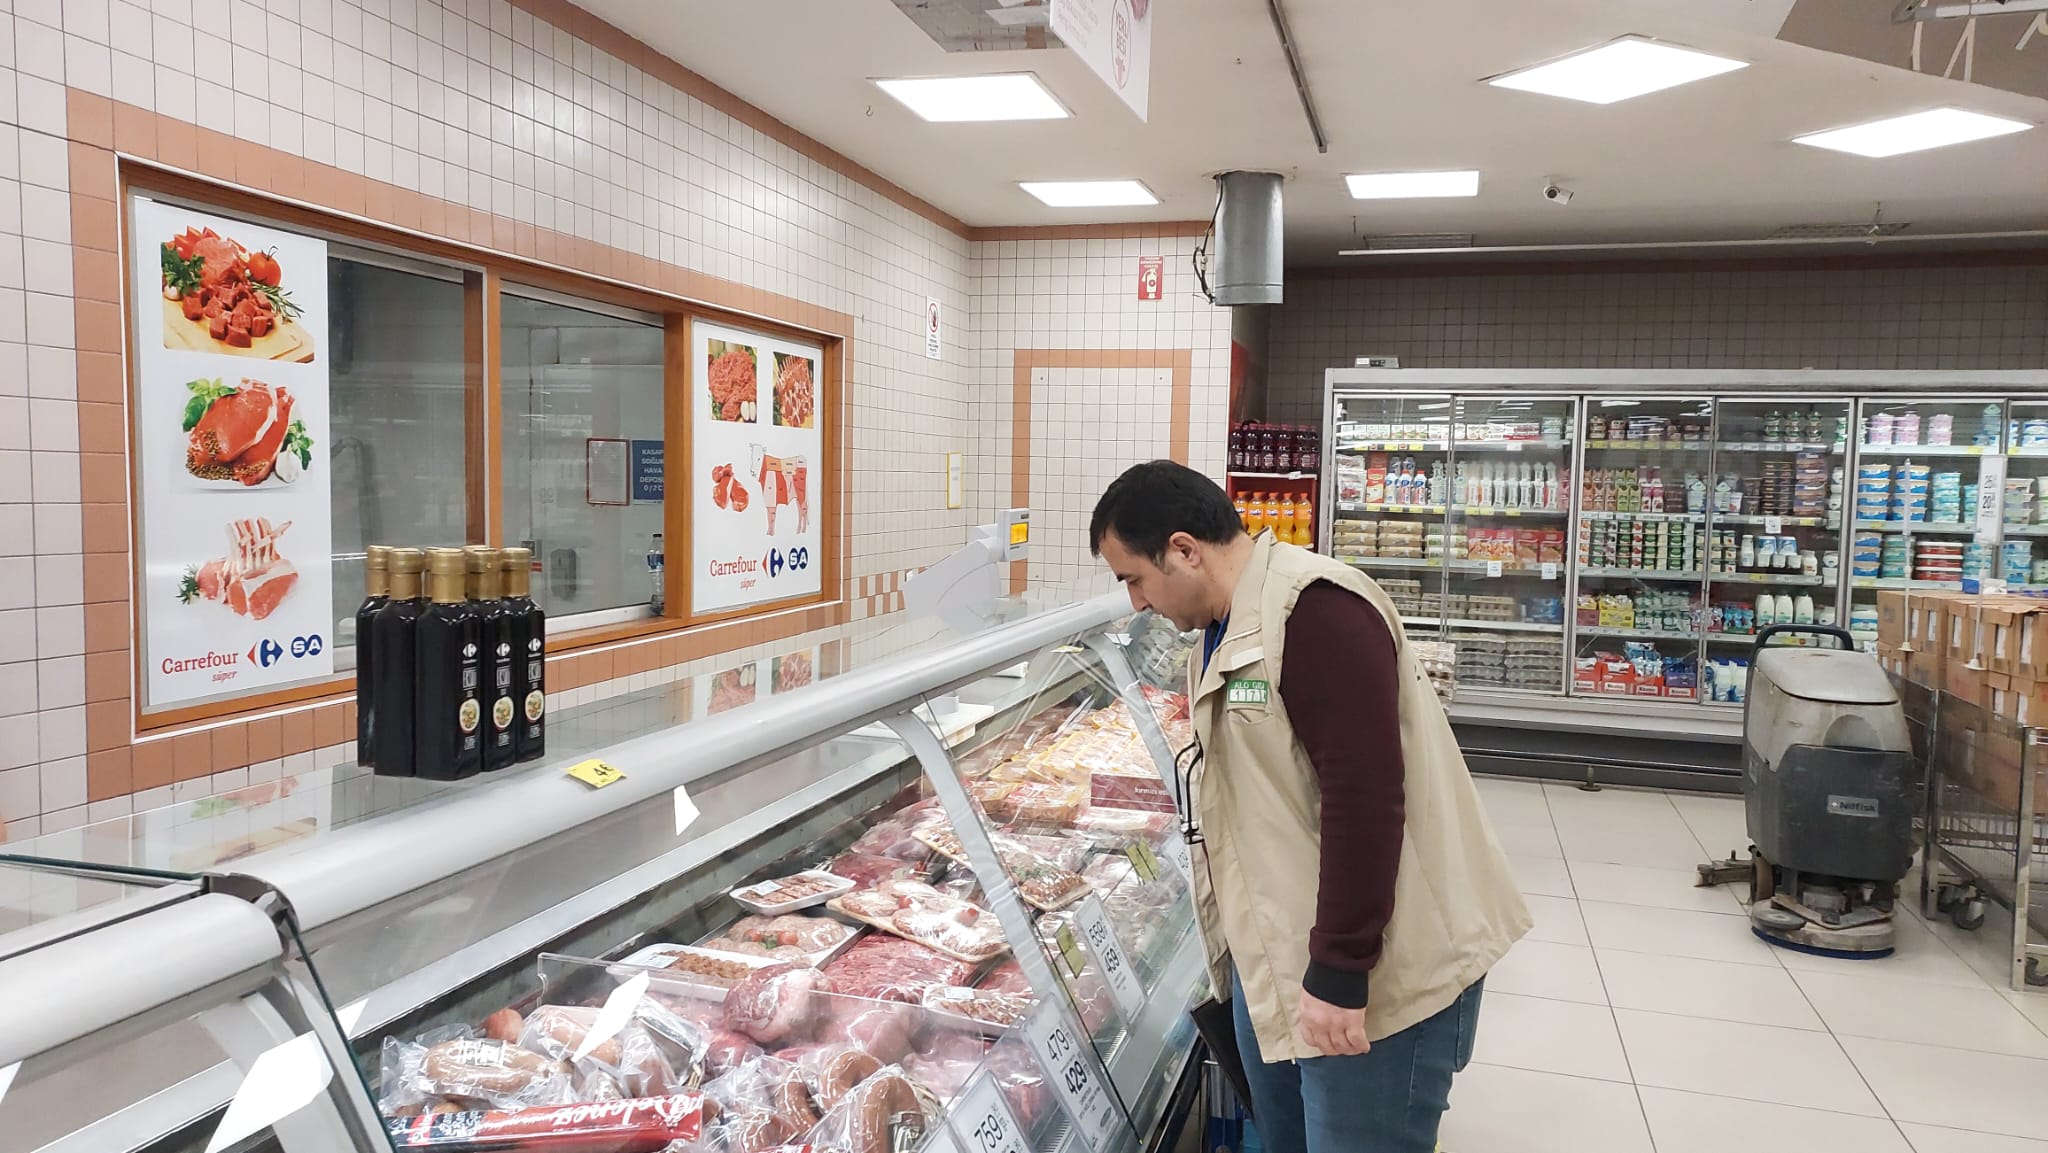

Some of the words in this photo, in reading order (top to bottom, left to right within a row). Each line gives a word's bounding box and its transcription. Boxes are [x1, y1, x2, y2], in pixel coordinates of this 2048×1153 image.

[709, 555, 757, 577] Carrefour
[162, 651, 239, 674] Carrefour
[211, 670, 237, 684] süper
[1233, 681, 1249, 690] ALO
[1089, 921, 1106, 948] 559
[1104, 948, 1121, 974] 459
[1046, 1028, 1070, 1062] 479
[1063, 1060, 1088, 1095] 429
[974, 1114, 1003, 1152] 759
